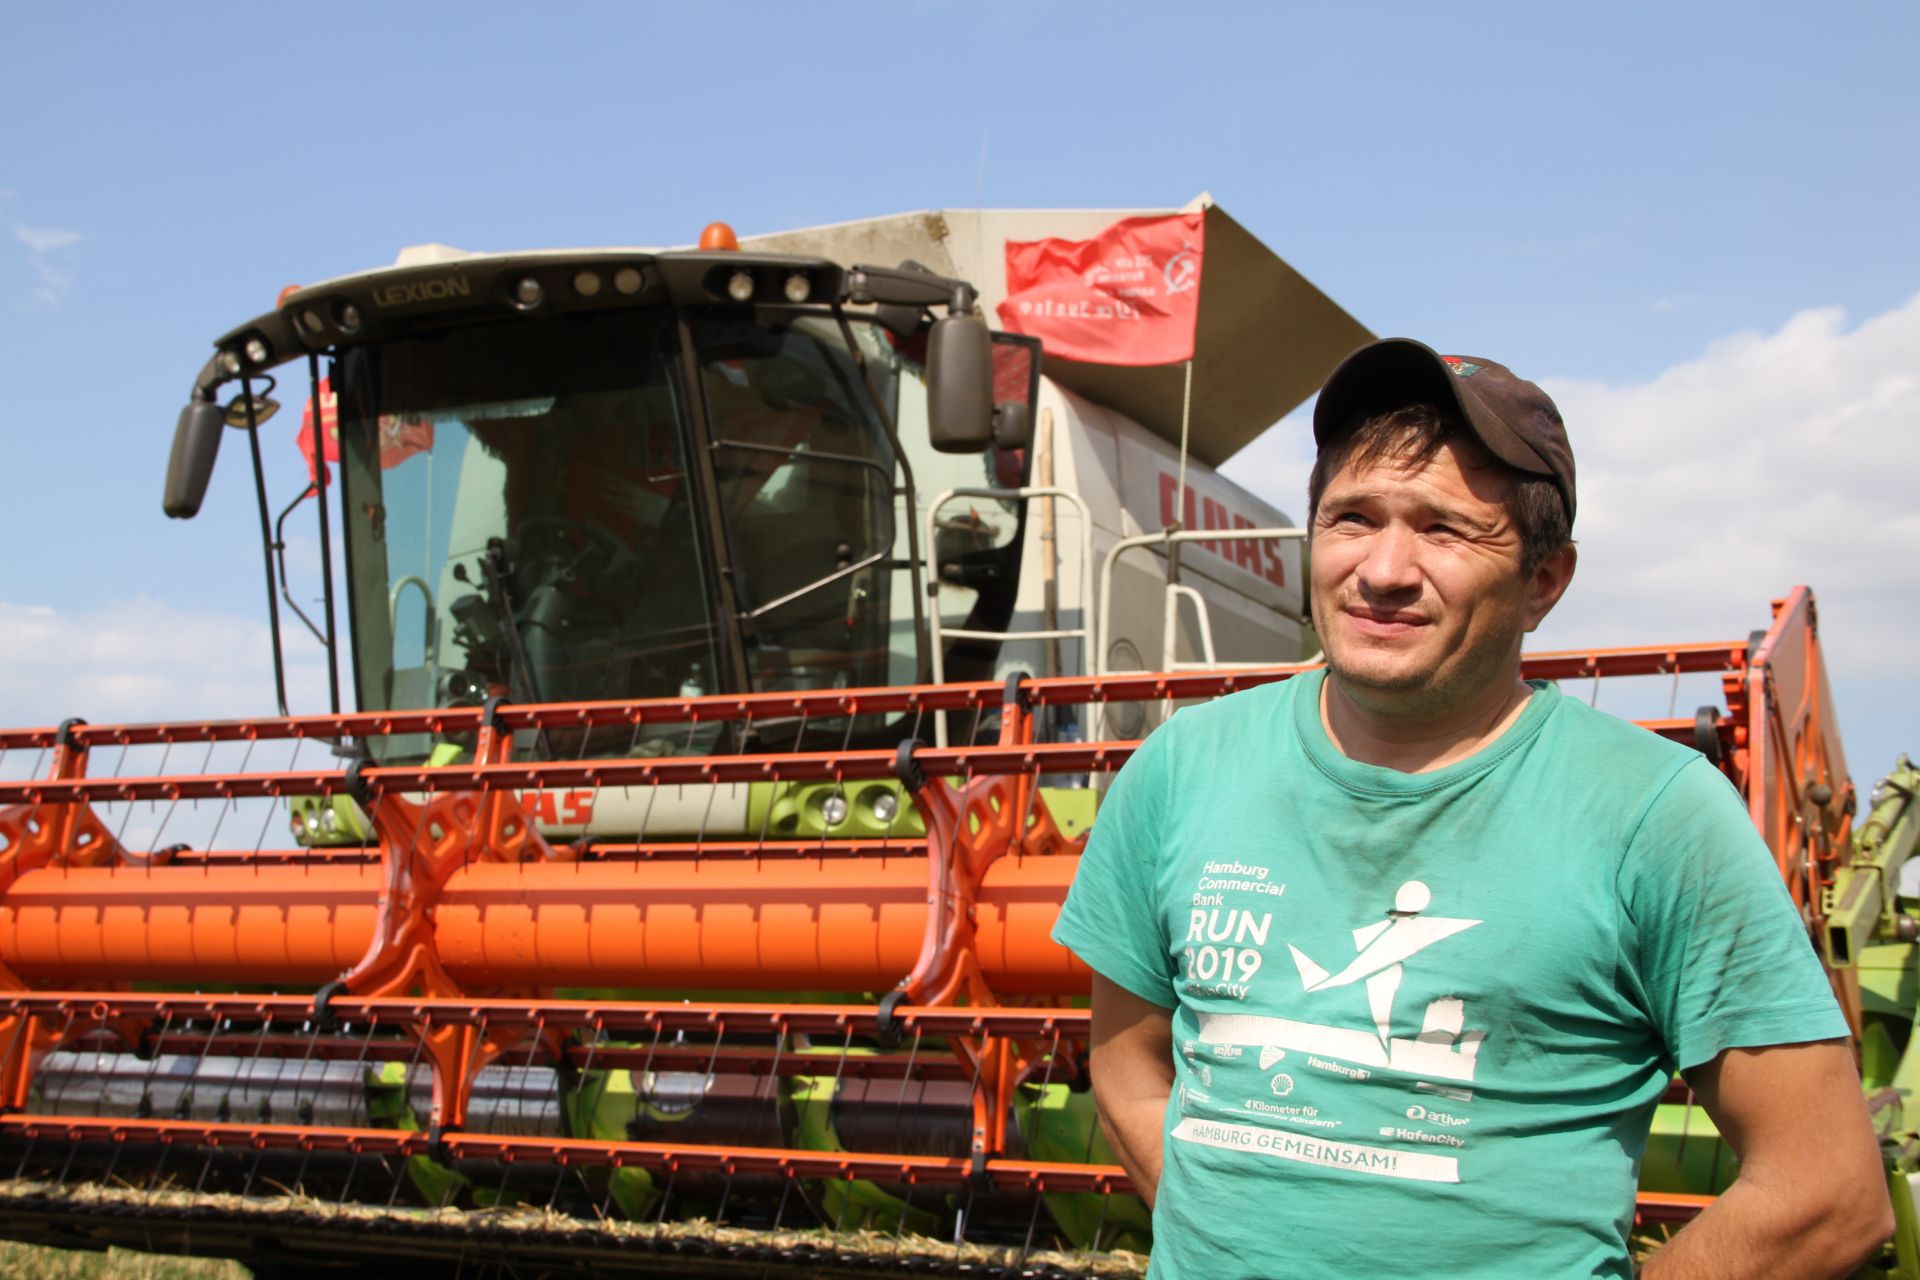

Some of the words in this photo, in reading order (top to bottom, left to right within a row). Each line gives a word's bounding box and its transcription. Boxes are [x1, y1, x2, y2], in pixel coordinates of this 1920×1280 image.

[371, 276, 471, 307] LEXION
[1202, 860, 1269, 880] Hamburg
[1198, 877, 1286, 896] Commercial
[1192, 893, 1224, 906] Bank
[1186, 909, 1272, 946] RUN
[1184, 945, 1262, 983] 2019
[1307, 1056, 1357, 1079] Hamburg
[1244, 1100, 1252, 1110] 4
[1252, 1100, 1300, 1115] Kilometer
[1302, 1105, 1318, 1117] für
[1396, 1128, 1465, 1149] HafenCity
[1256, 1134, 1397, 1170] GEMEINSAM!
